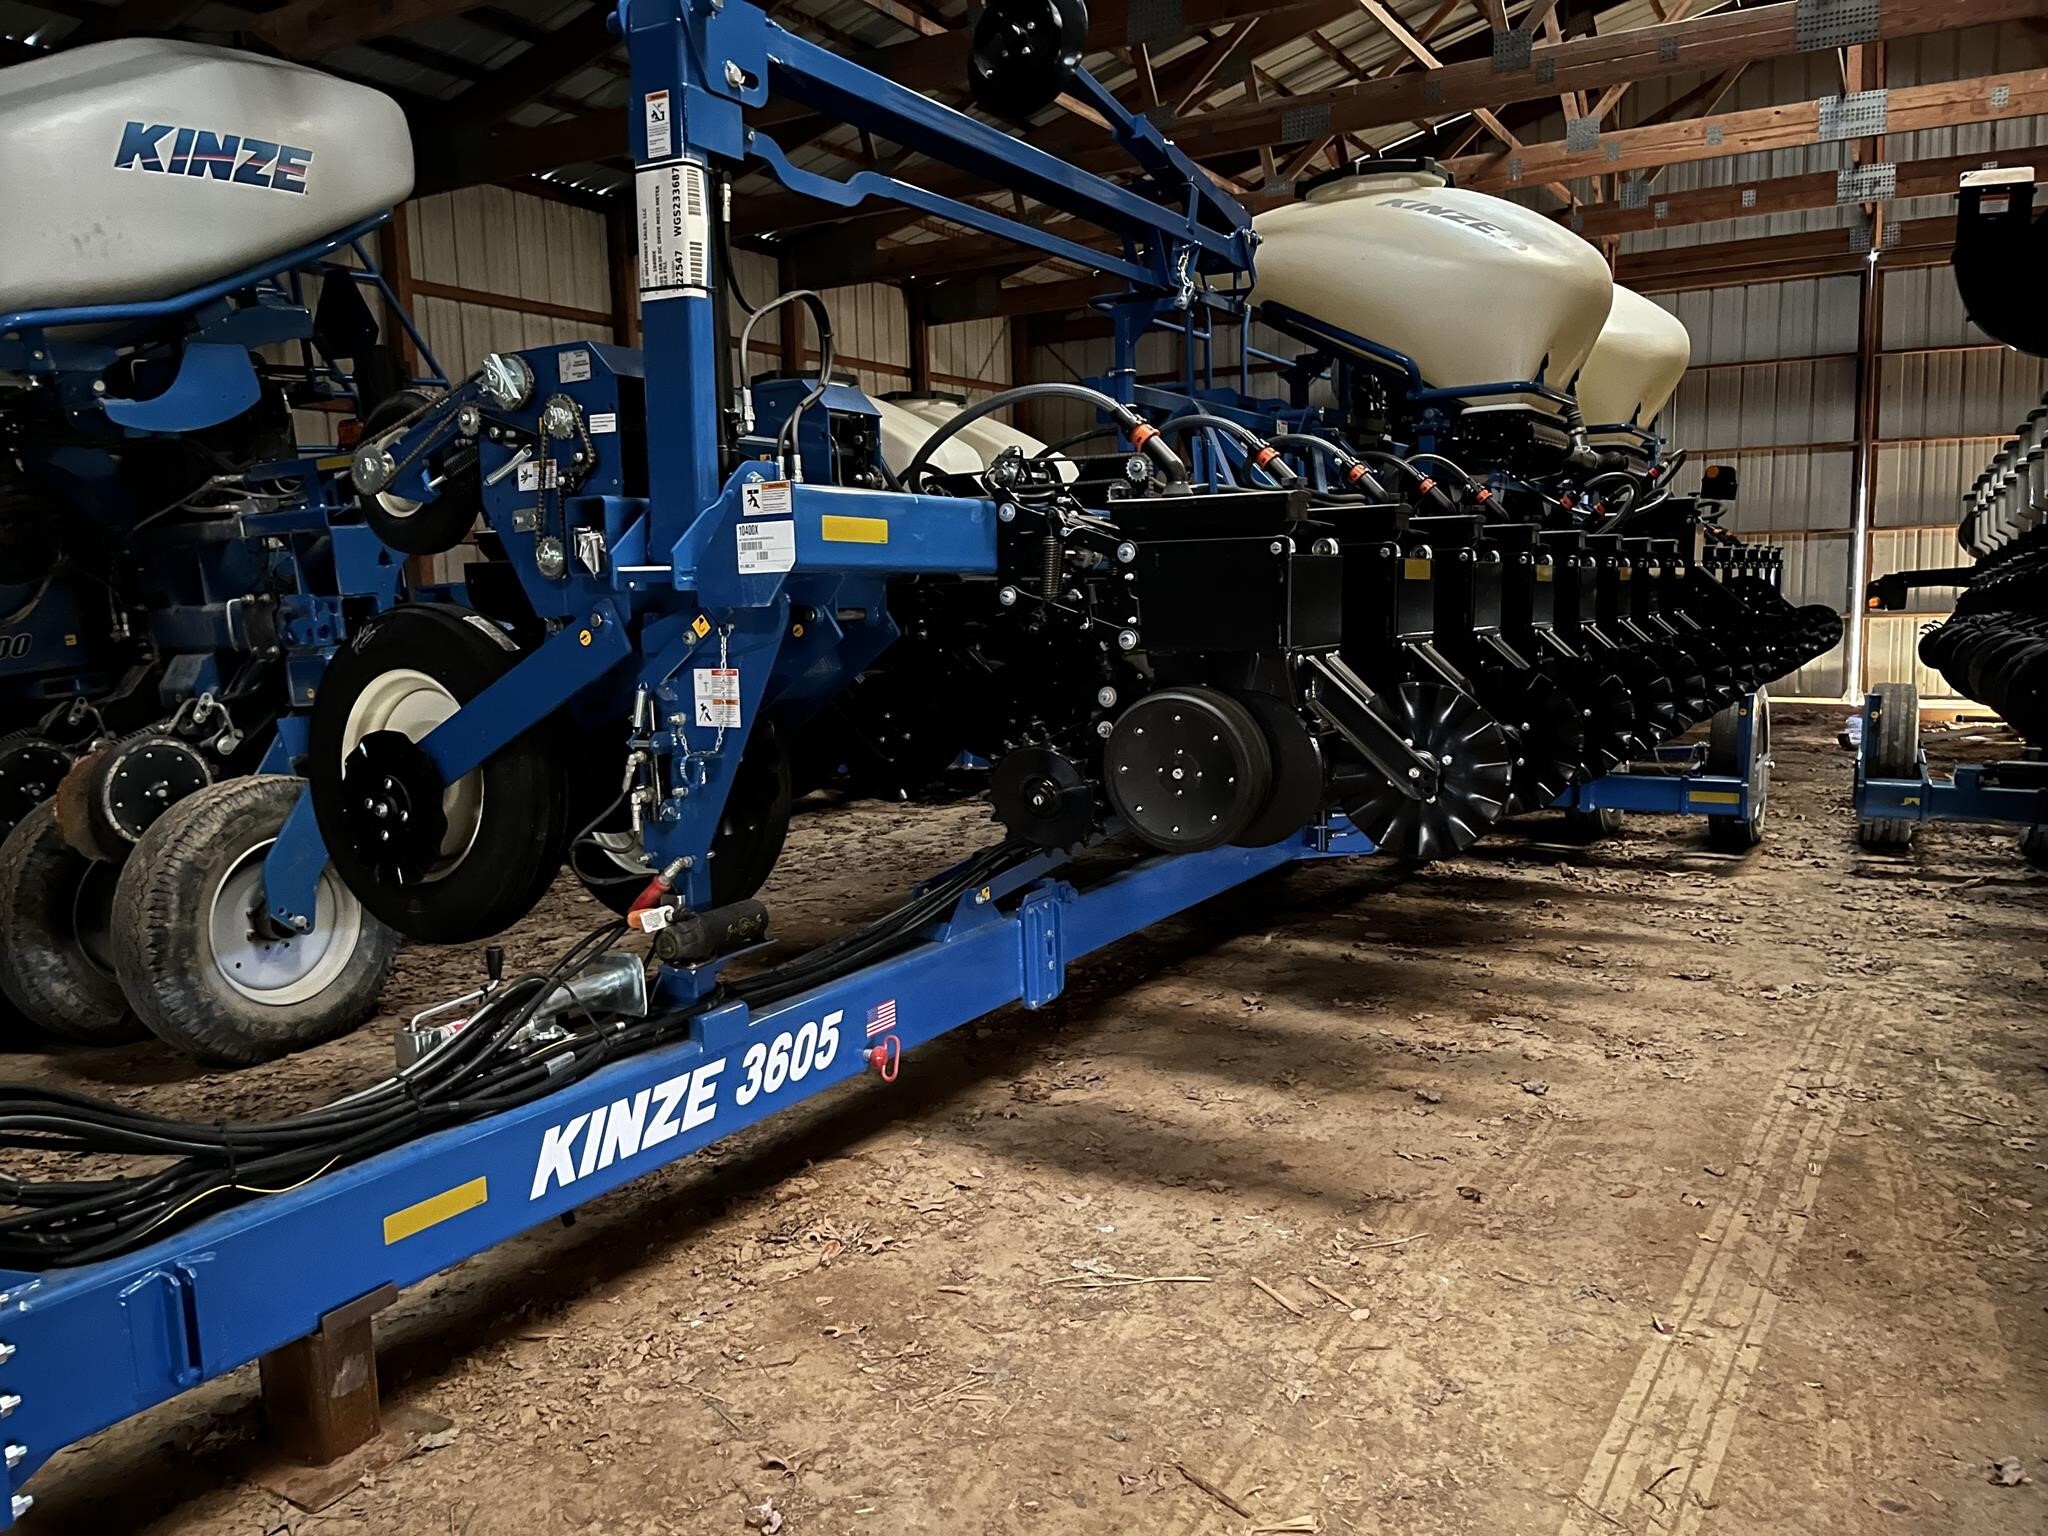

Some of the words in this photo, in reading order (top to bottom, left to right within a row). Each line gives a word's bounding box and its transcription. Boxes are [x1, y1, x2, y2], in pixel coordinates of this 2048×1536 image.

[113, 120, 313, 195] KINZE
[672, 168, 682, 237] WGS233687
[1375, 198, 1508, 238] KINZE
[529, 1057, 726, 1201] KINZE
[736, 1009, 844, 1105] 3605
